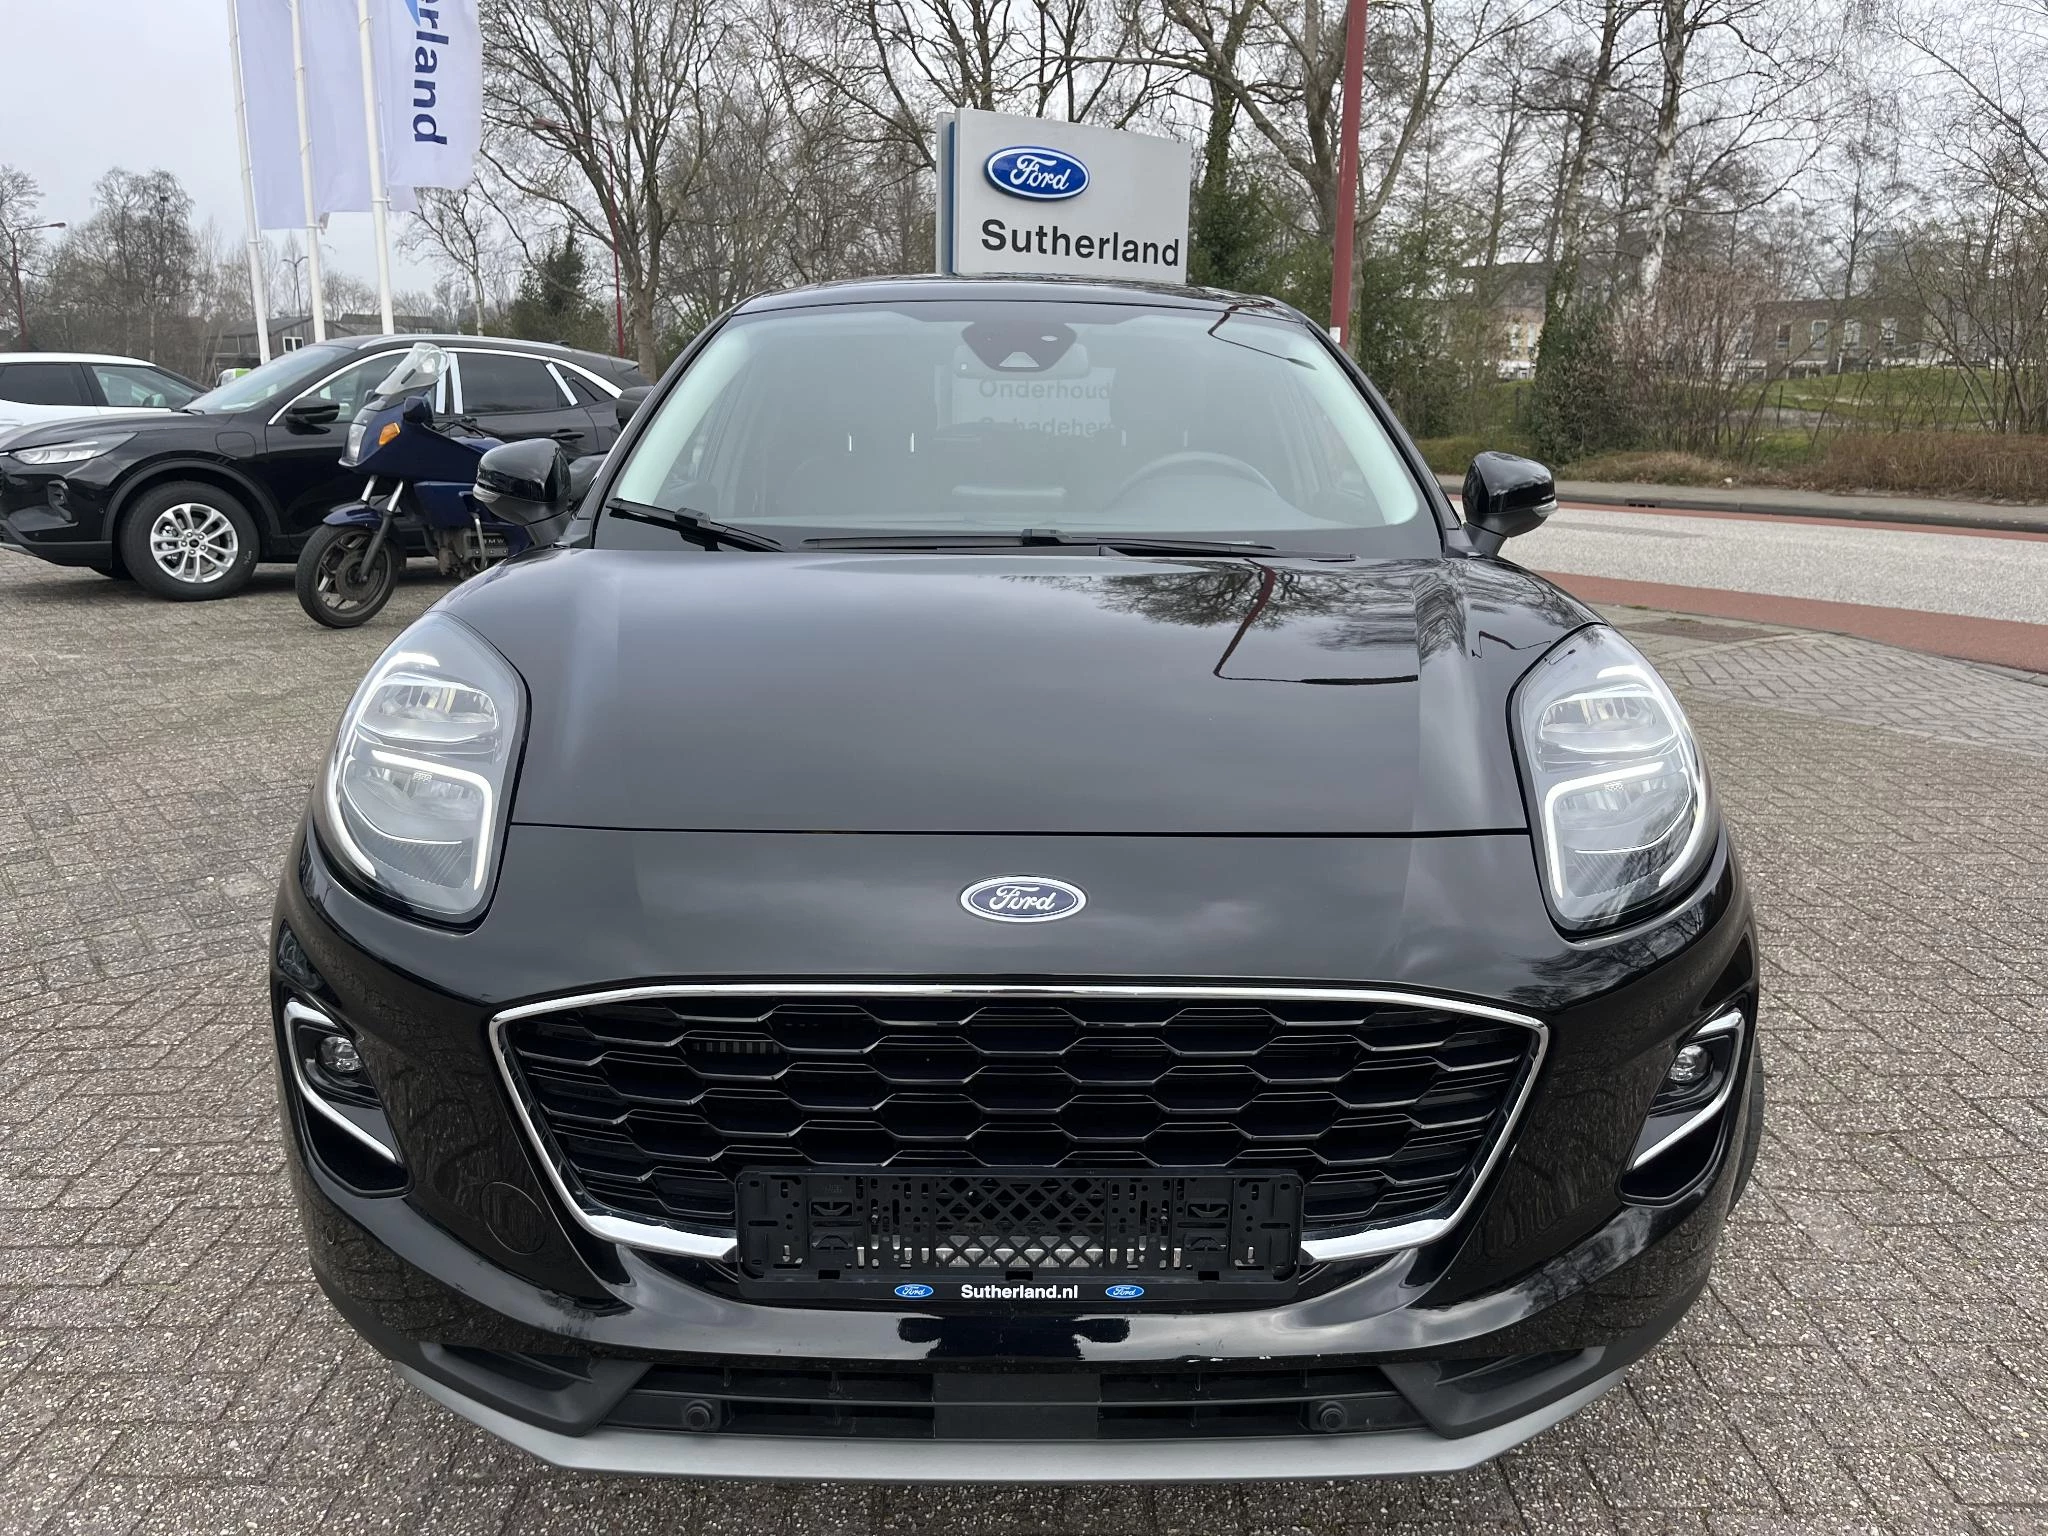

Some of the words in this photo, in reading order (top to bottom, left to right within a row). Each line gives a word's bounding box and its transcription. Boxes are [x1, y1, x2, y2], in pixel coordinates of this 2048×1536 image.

[412, 0, 449, 145] rland
[1010, 154, 1072, 190] Ford
[981, 218, 1179, 267] Sutherland
[978, 378, 1110, 399] Onderhoud
[989, 885, 1057, 910] Ford
[901, 1284, 926, 1297] Ford
[961, 1284, 1079, 1299] Sutherland.nl
[1112, 1284, 1137, 1297] Ford
